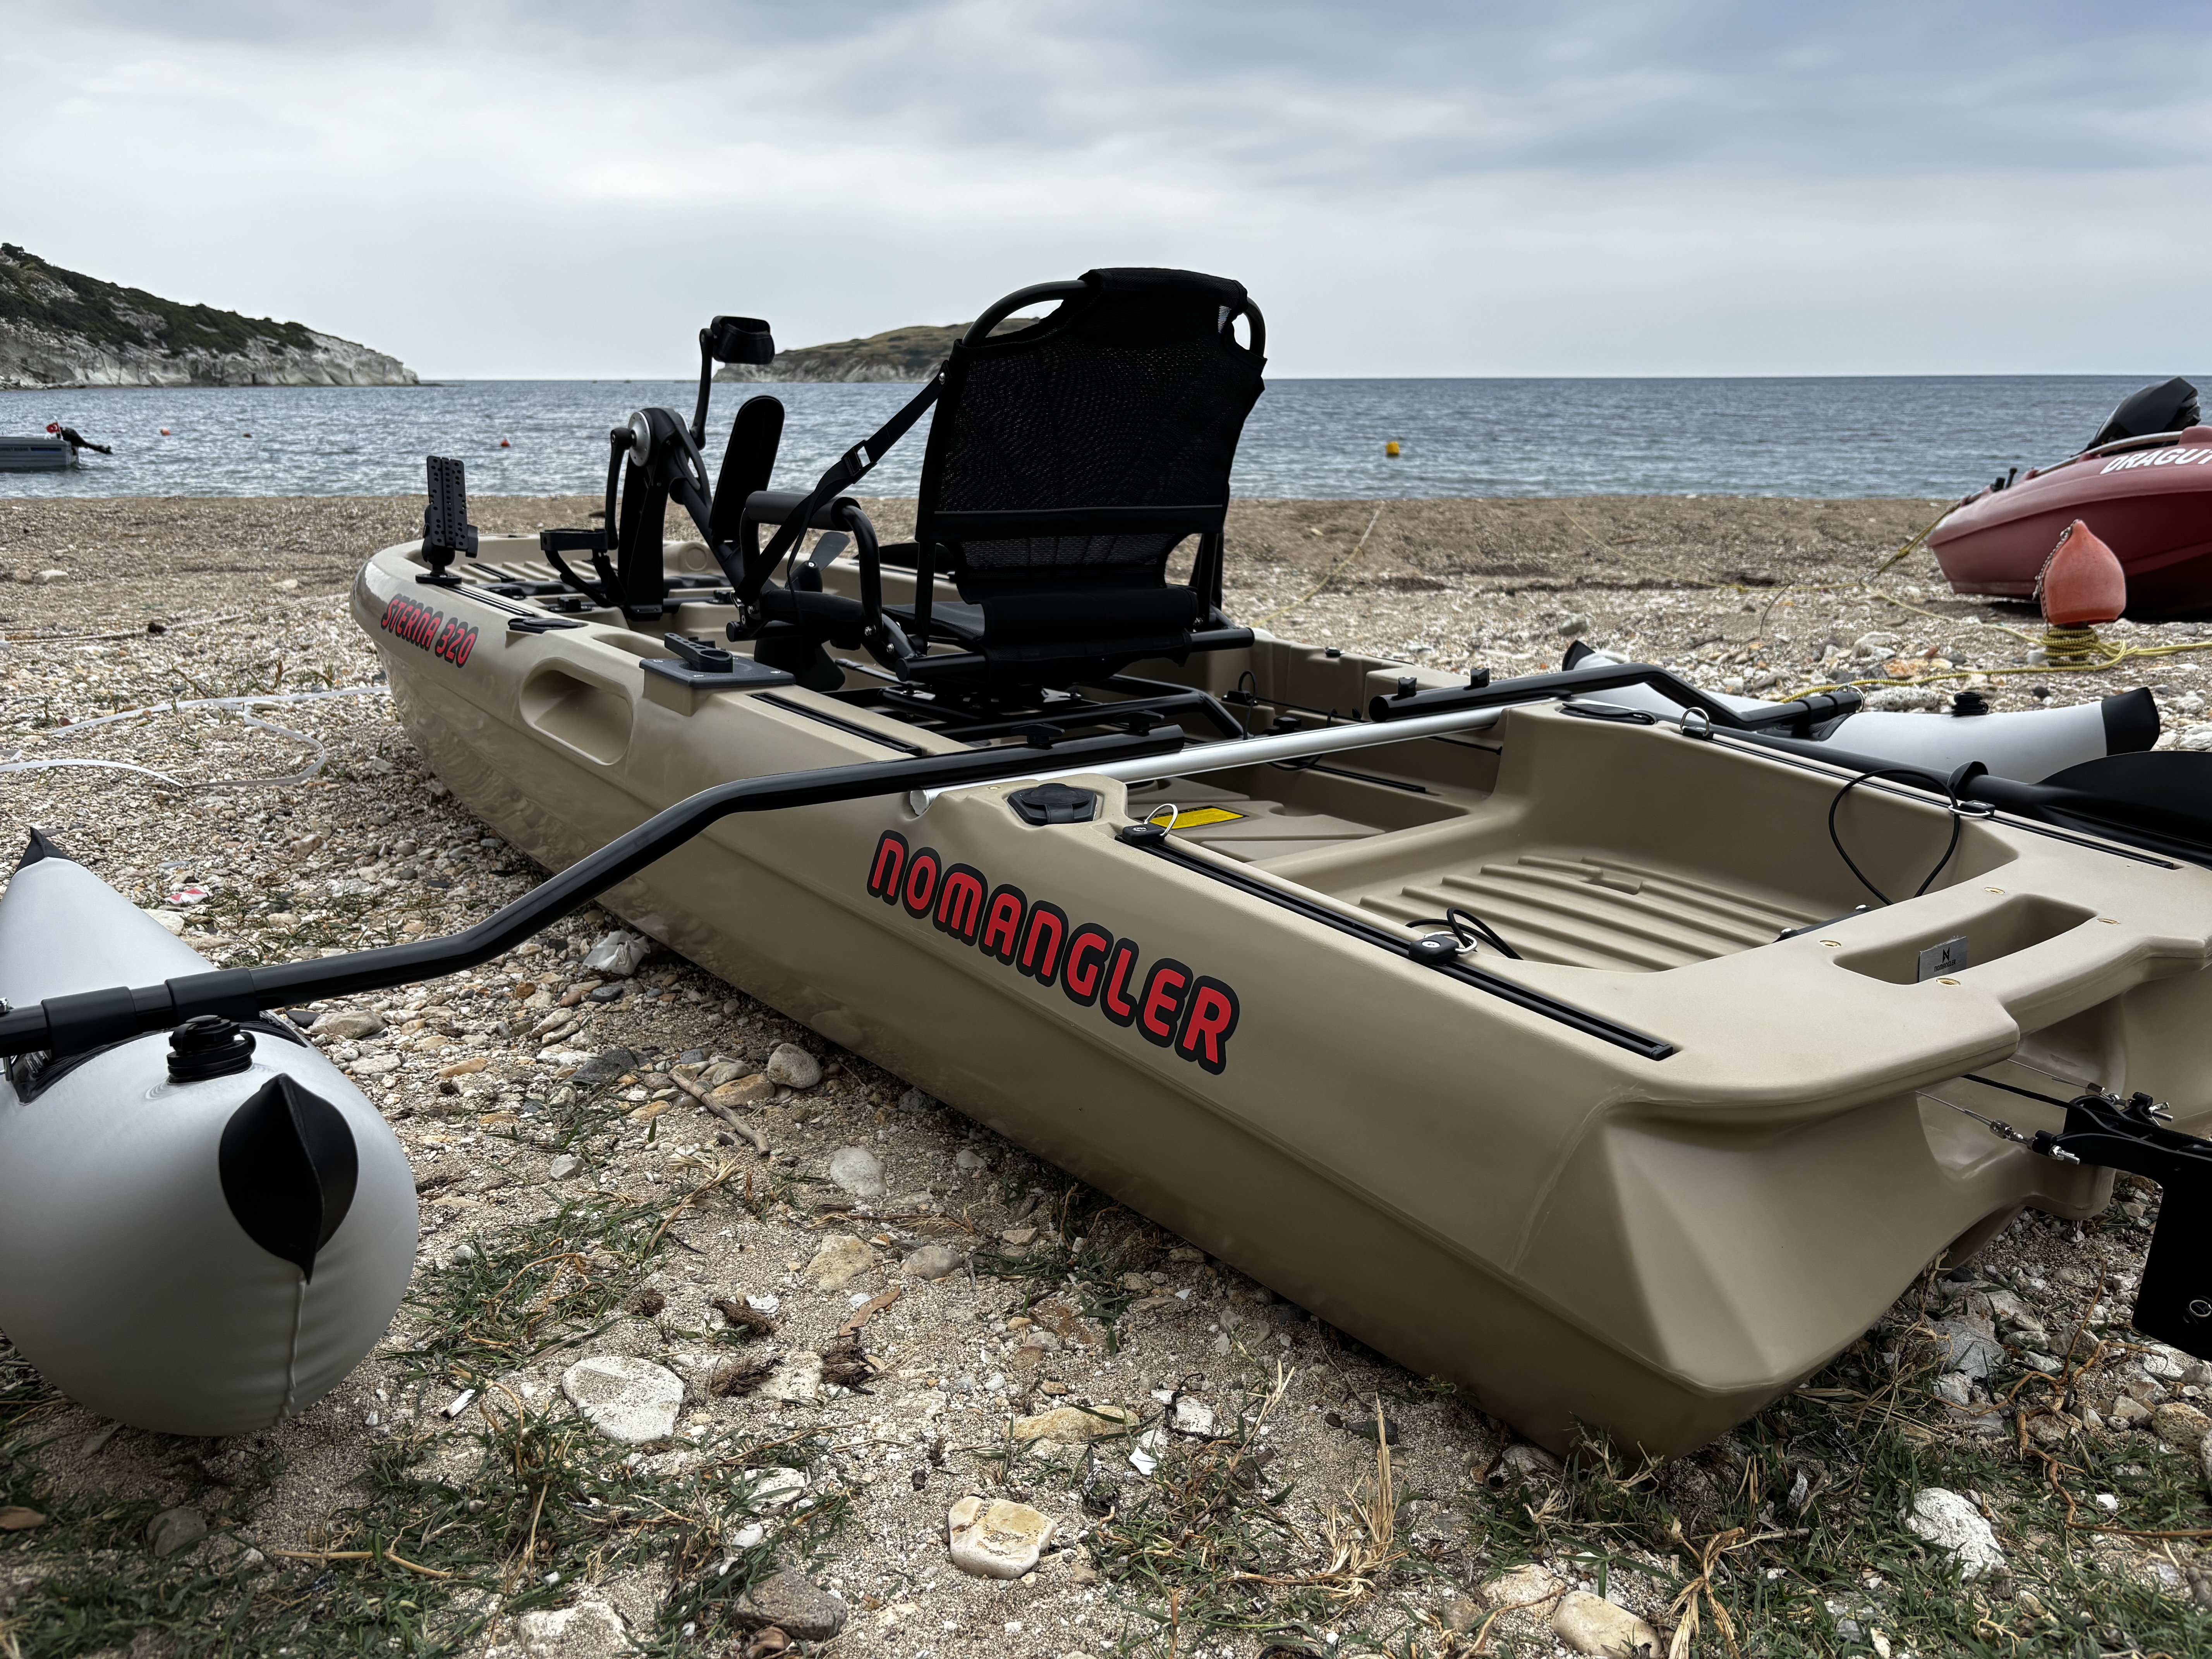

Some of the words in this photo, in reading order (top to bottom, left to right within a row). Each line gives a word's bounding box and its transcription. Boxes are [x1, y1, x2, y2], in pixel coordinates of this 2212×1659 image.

[381, 594, 443, 651] STERNA
[435, 618, 478, 667] 320
[868, 830, 1238, 1074] NOMANGLER
